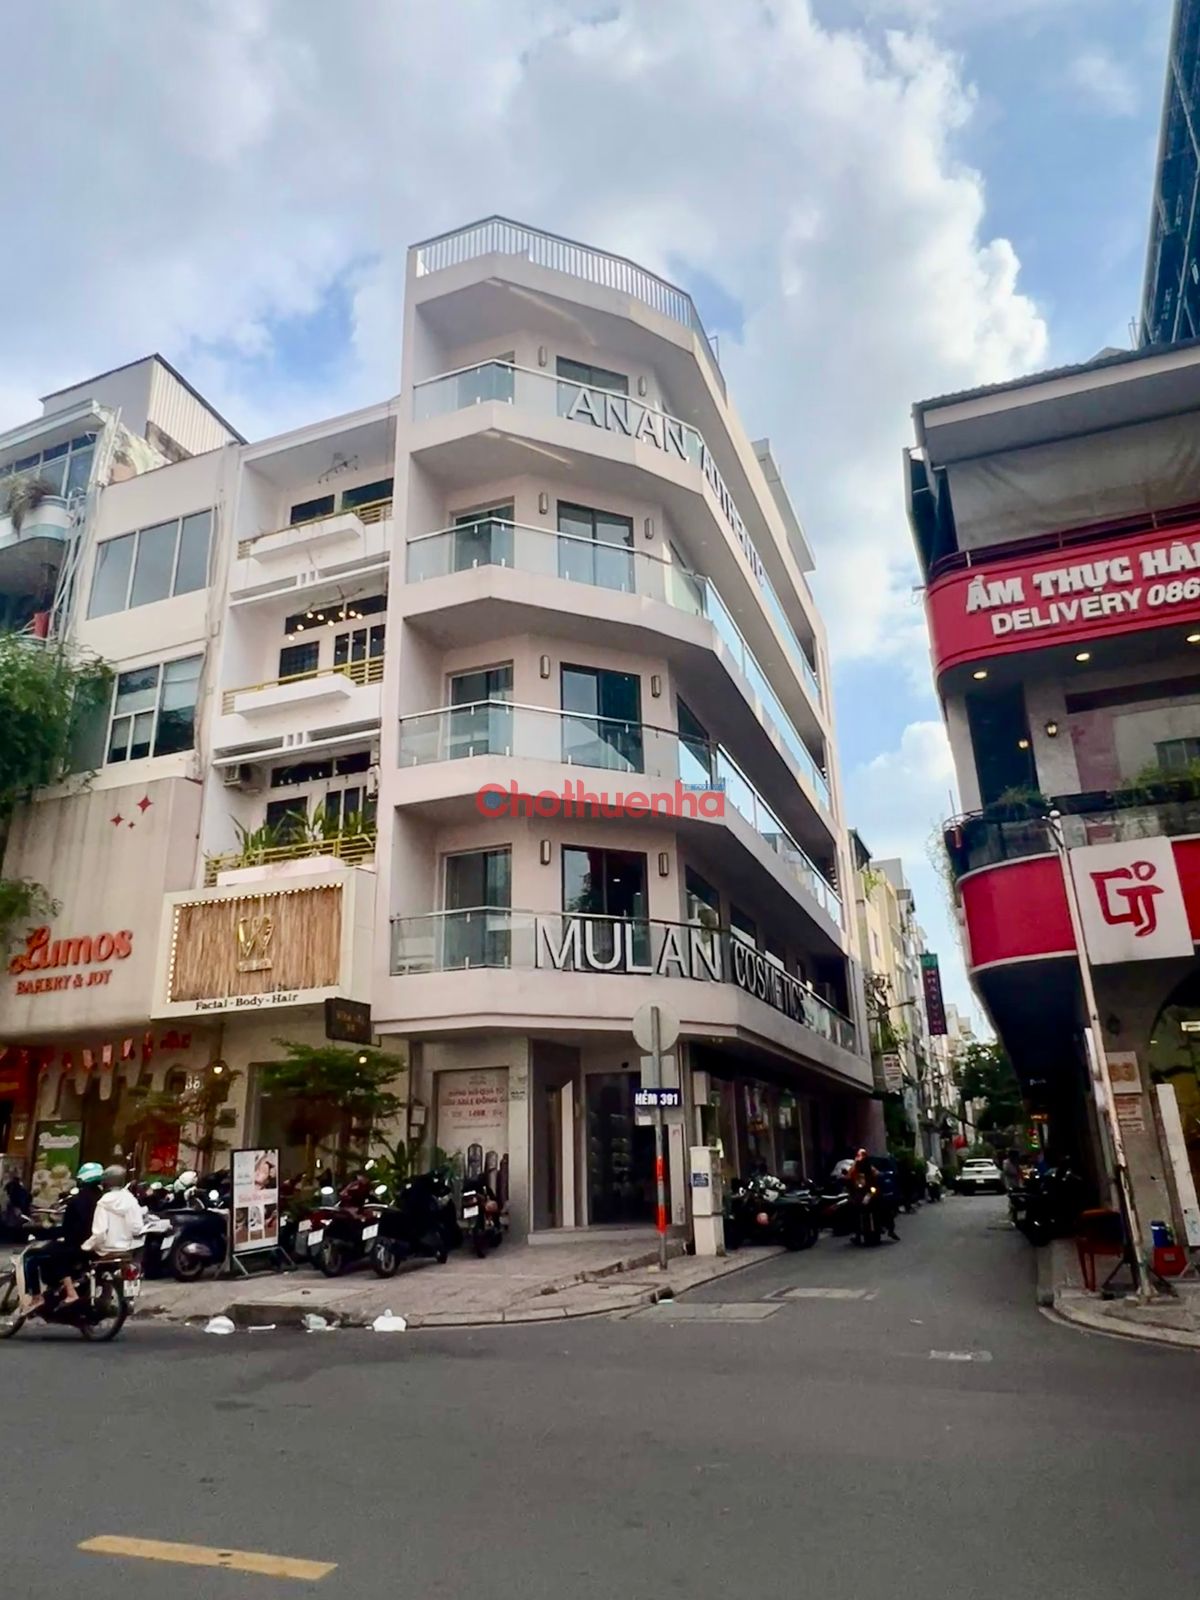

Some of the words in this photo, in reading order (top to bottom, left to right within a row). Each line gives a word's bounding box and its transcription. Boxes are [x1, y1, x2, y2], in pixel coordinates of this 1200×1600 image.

[567, 387, 688, 461] ANAN
[966, 575, 1025, 613] ẨM
[1033, 556, 1133, 598] THỰC
[991, 588, 1142, 636] DELIVERY
[8, 925, 134, 975] Lumos
[535, 917, 722, 982] MULAN
[16, 975, 71, 995] BAKERY
[73, 973, 84, 988] &
[87, 969, 113, 986] JOY
[195, 999, 228, 1011] Facial
[235, 996, 263, 1009] Body
[272, 992, 299, 1005] Hair
[660, 1093, 678, 1105] 391
